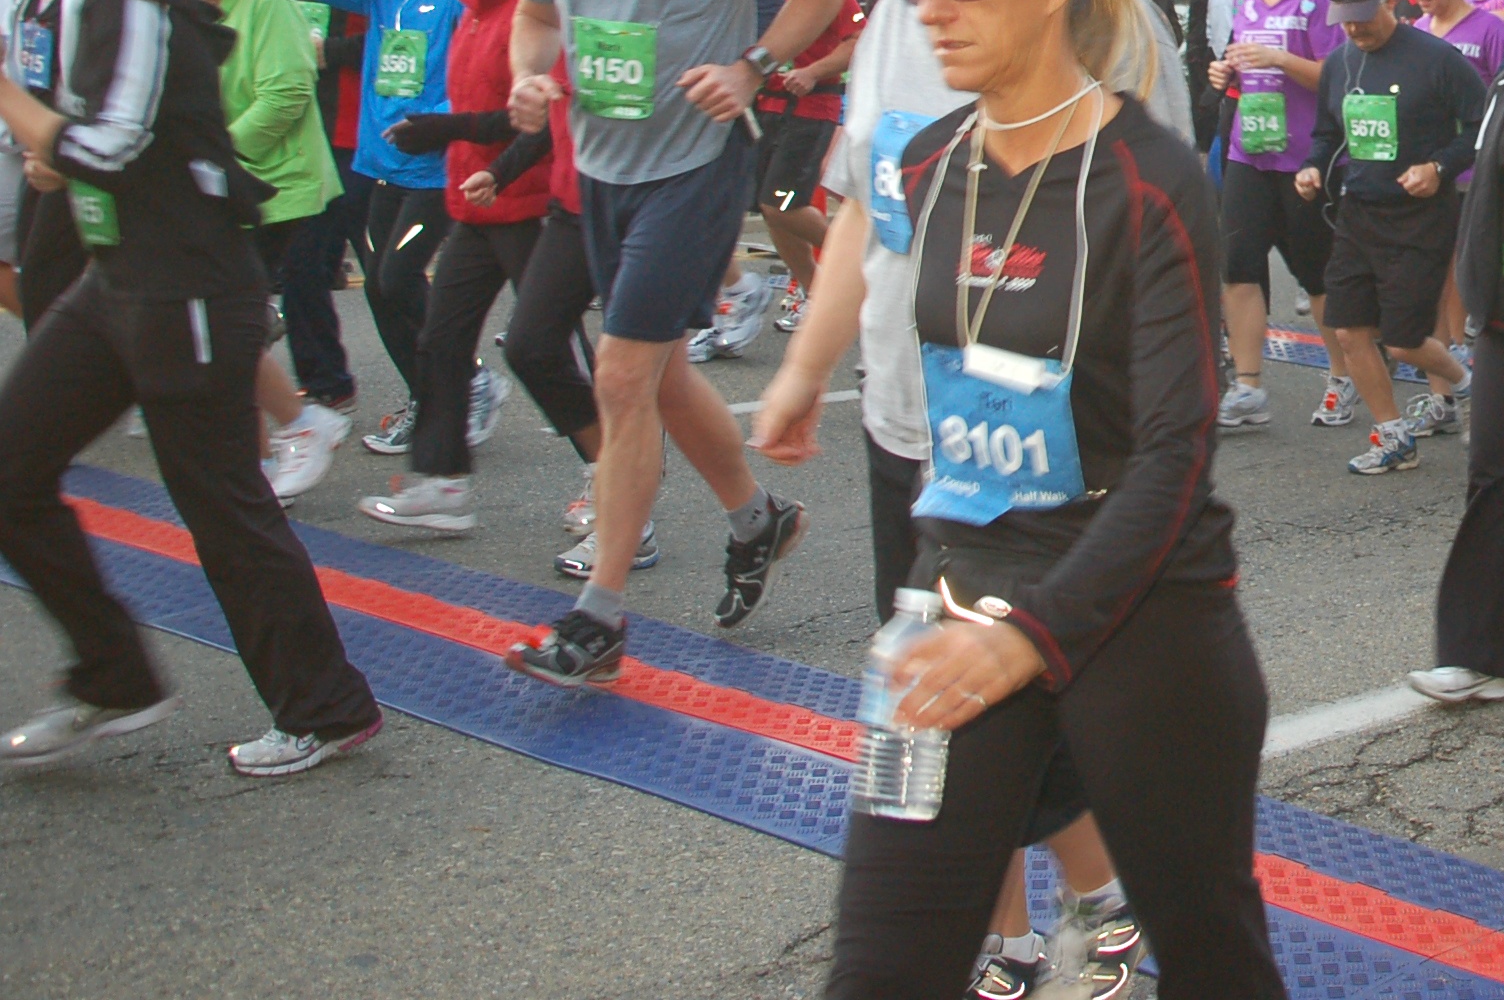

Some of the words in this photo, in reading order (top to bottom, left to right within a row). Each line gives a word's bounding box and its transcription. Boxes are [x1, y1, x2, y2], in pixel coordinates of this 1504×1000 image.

[579, 55, 644, 84] 4150
[1350, 120, 1390, 137] 5678
[938, 414, 1050, 478] 8101
